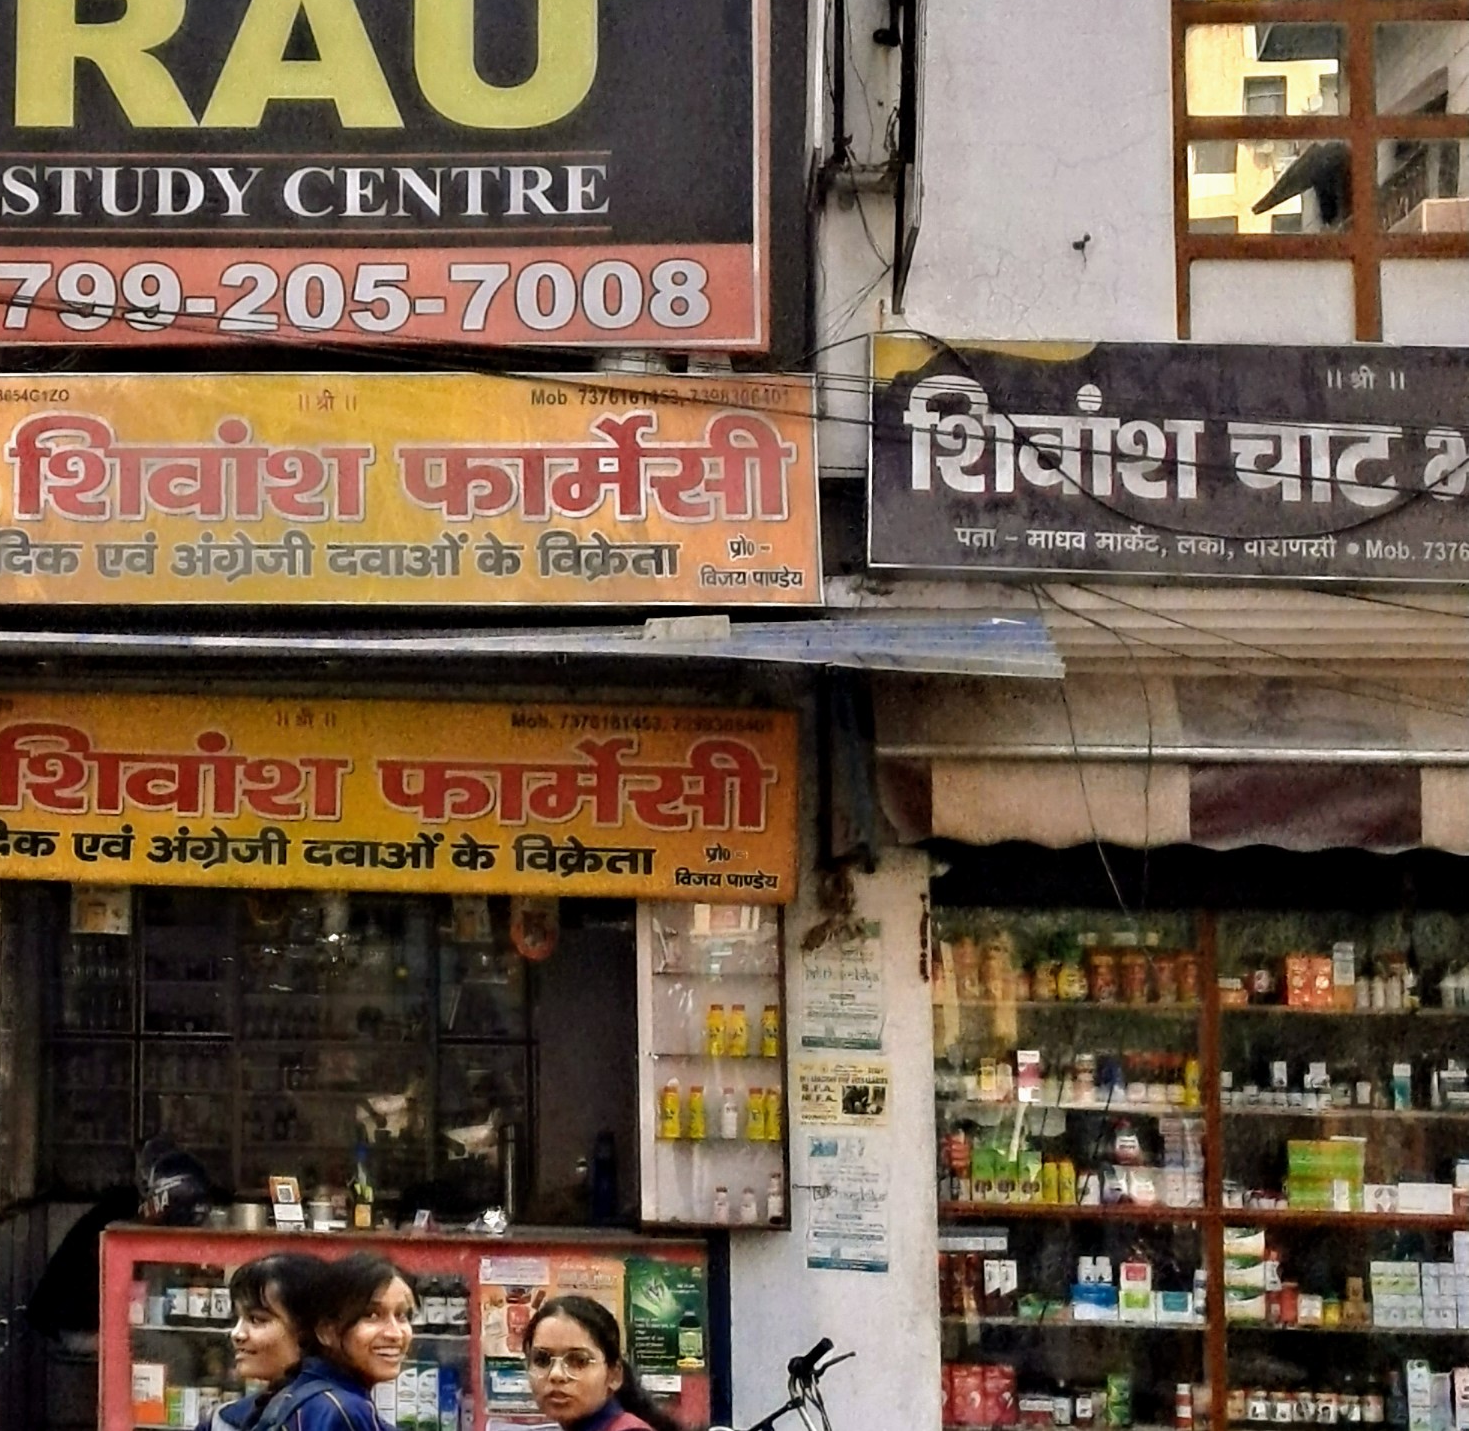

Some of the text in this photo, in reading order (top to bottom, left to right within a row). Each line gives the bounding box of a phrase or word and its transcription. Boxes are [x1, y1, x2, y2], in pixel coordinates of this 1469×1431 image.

[1, 163, 612, 220] STUDY CENTRE
[1351, 365, 1375, 389] श्री
[8, 412, 795, 519] शिवांश फार्मेसी
[904, 375, 1205, 500] शिवांश
[1227, 421, 1403, 507] चाट
[96, 531, 159, 576] एवं
[171, 530, 316, 583] अंग्रेजी
[327, 532, 468, 576] दवाओं
[474, 532, 523, 577] के
[537, 531, 680, 581] विक्रेता
[954, 526, 996, 548] पता
[1026, 528, 1086, 551] माधव
[1366, 540, 1416, 560] Mob.
[701, 565, 803, 588] विजय पाण्डेय
[377, 738, 777, 831] फार्मेसी
[72, 824, 135, 862] एवं
[146, 824, 291, 869] अंग्रेजी
[302, 833, 445, 869] दवाओं
[451, 832, 499, 871] के
[512, 834, 656, 878] विक्रेता
[675, 867, 778, 889] विजय पाण्डेय
